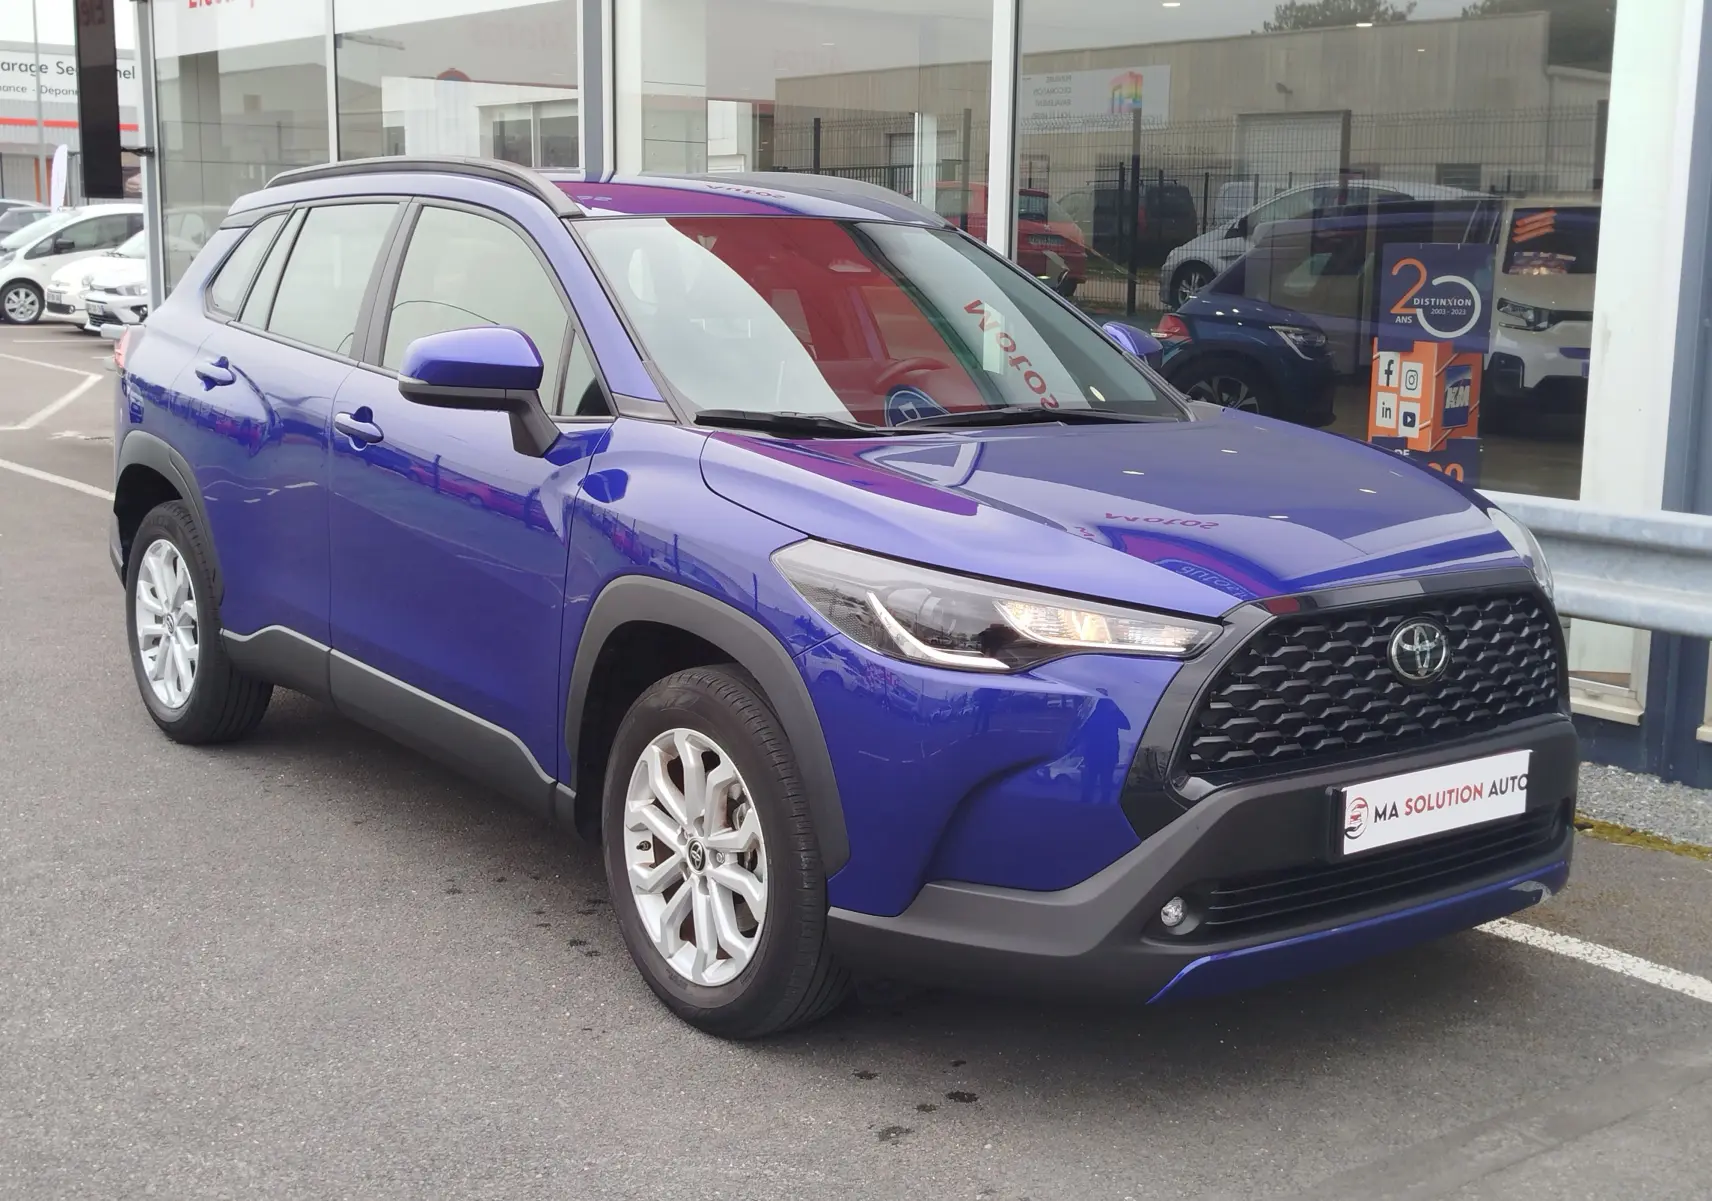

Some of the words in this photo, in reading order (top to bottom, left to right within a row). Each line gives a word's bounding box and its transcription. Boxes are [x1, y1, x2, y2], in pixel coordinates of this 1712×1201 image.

[0, 61, 49, 77] arage
[1413, 297, 1472, 307] DISTINXION
[1430, 307, 1446, 316] 2003
[1451, 308, 1467, 316] 2023
[1395, 315, 1413, 324] ANS
[1373, 801, 1399, 823] MA
[1404, 782, 1484, 816] SOLUTION
[1488, 773, 1529, 798] AUTO
